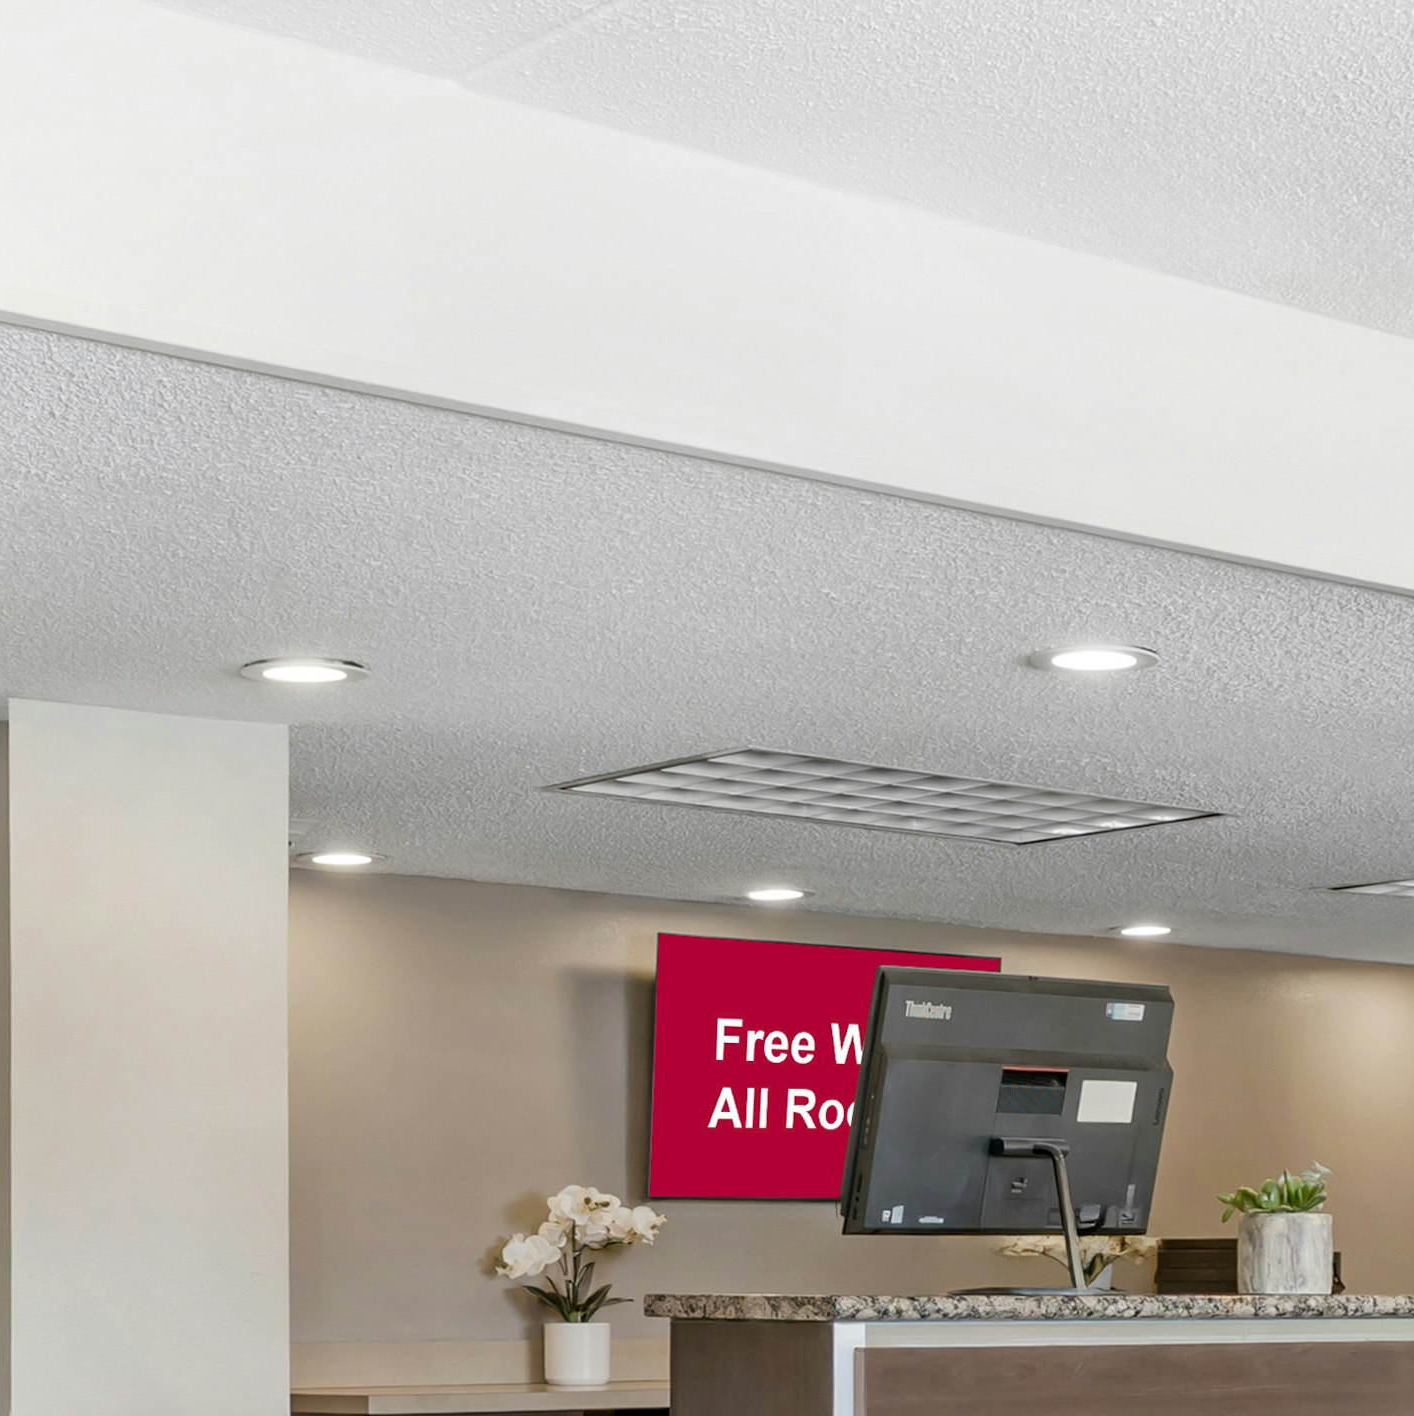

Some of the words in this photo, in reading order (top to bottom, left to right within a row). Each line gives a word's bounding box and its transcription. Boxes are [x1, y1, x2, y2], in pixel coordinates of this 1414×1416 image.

[715, 1018, 816, 1064] Free
[707, 1087, 769, 1129] All
[785, 1088, 856, 1130] Ro
